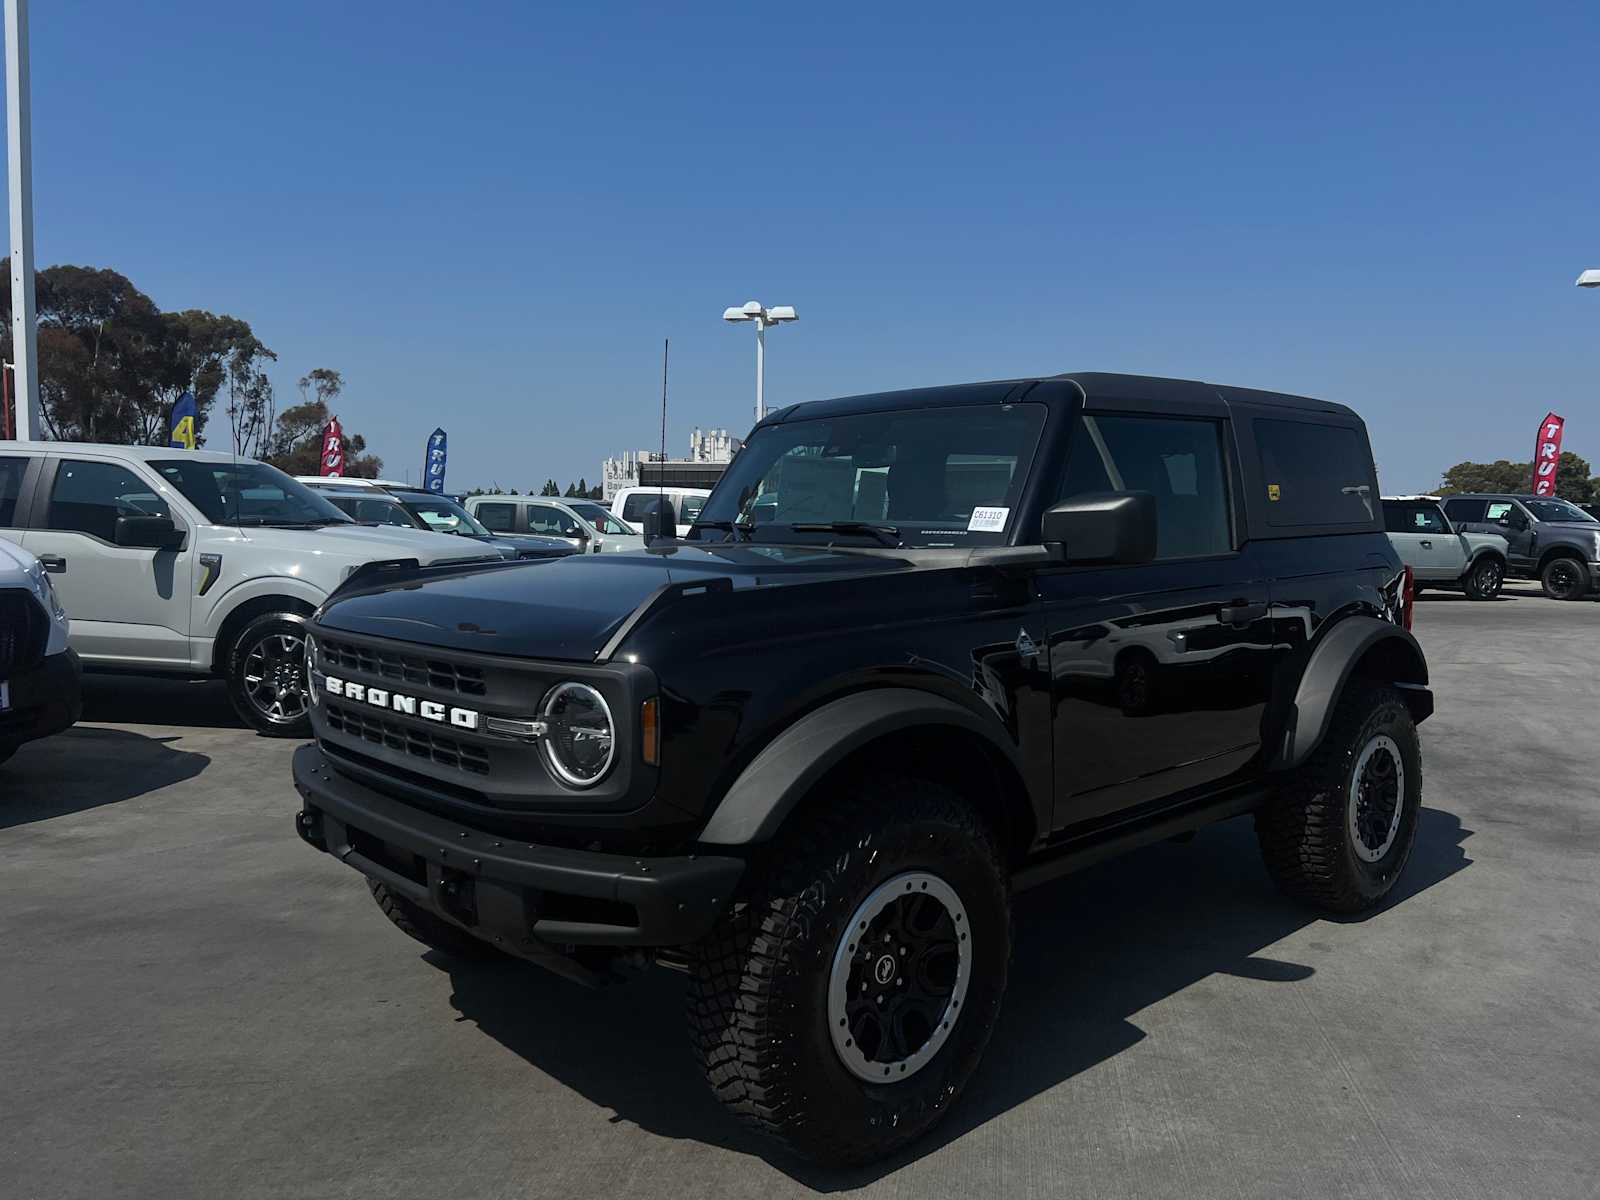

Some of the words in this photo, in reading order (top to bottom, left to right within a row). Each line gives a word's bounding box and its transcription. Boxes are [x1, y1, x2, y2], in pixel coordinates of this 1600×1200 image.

[172, 416, 195, 449] 4
[1537, 423, 1560, 495] TRUC
[974, 510, 1003, 520] C61310
[326, 676, 479, 729] BRONCO
